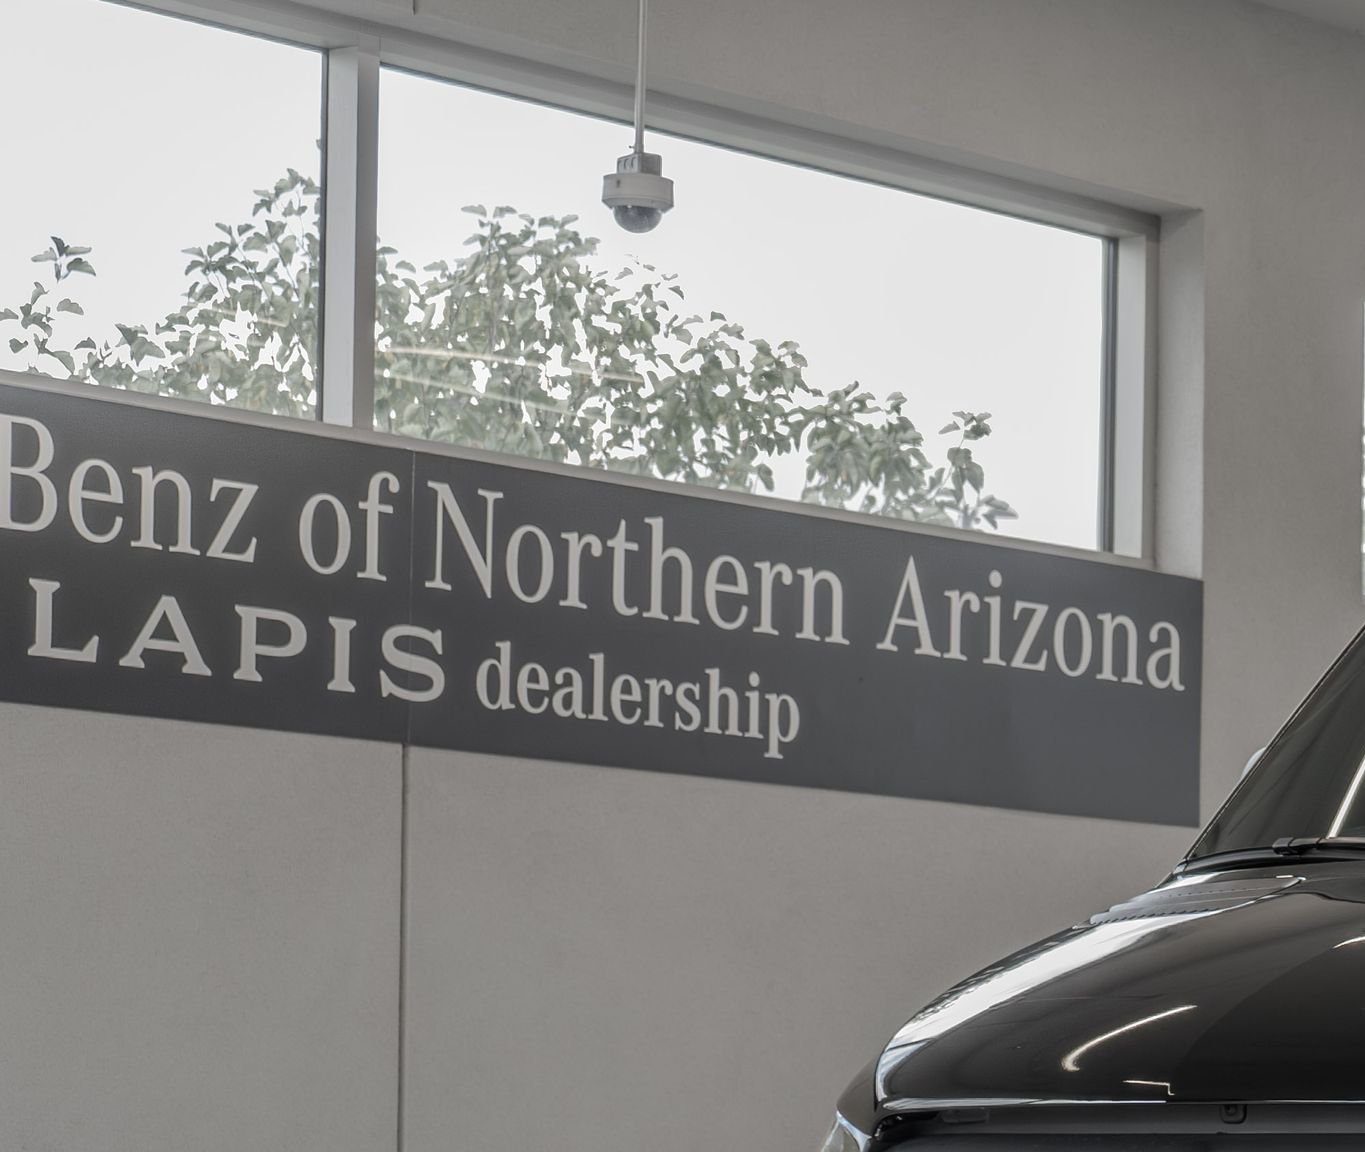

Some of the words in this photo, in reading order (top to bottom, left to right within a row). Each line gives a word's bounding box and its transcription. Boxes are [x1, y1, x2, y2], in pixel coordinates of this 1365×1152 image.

[0, 414, 260, 563] Benz
[299, 471, 400, 581] of
[425, 480, 850, 645] Northern
[876, 555, 1185, 691] Arizona
[27, 577, 446, 703] LAPIS
[475, 640, 800, 759] dealership
